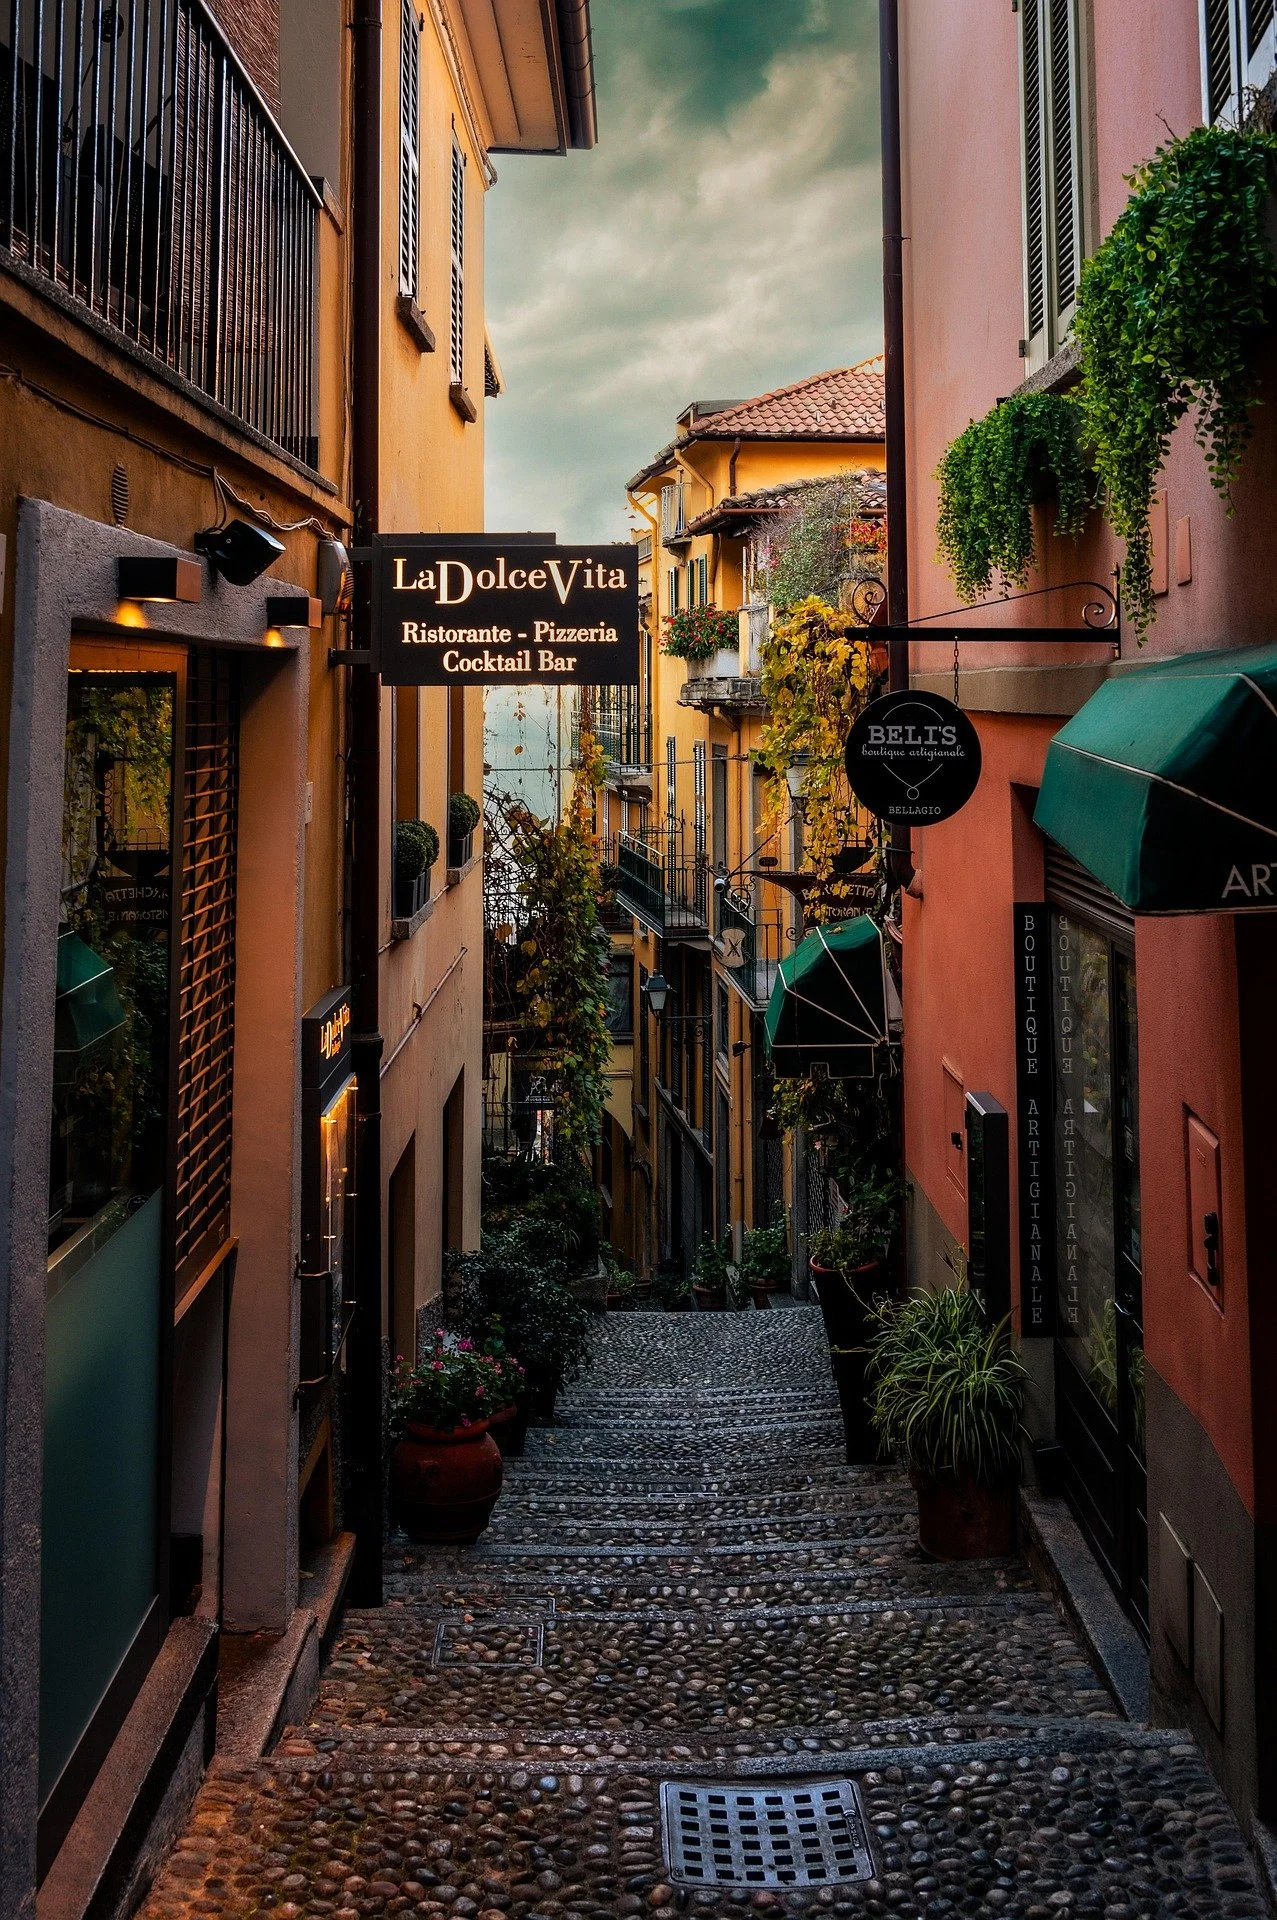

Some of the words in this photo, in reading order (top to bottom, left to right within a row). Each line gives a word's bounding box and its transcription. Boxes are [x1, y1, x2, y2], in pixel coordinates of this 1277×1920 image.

[402, 622, 511, 643] Ristorante
[534, 622, 618, 643] Pizzeria
[443, 650, 531, 672] Cocktail
[538, 650, 576, 672] Bar
[868, 725, 957, 745] BELI'S
[862, 744, 905, 759] boutique
[909, 745, 966, 761] artigianale
[889, 806, 941, 815] BELLAGIO
[1221, 863, 1277, 899] AR
[801, 884, 876, 900] BRETTA
[1024, 915, 1038, 1075] BOUTIQUE
[1027, 1099, 1043, 1324] ARTIGIANALE
